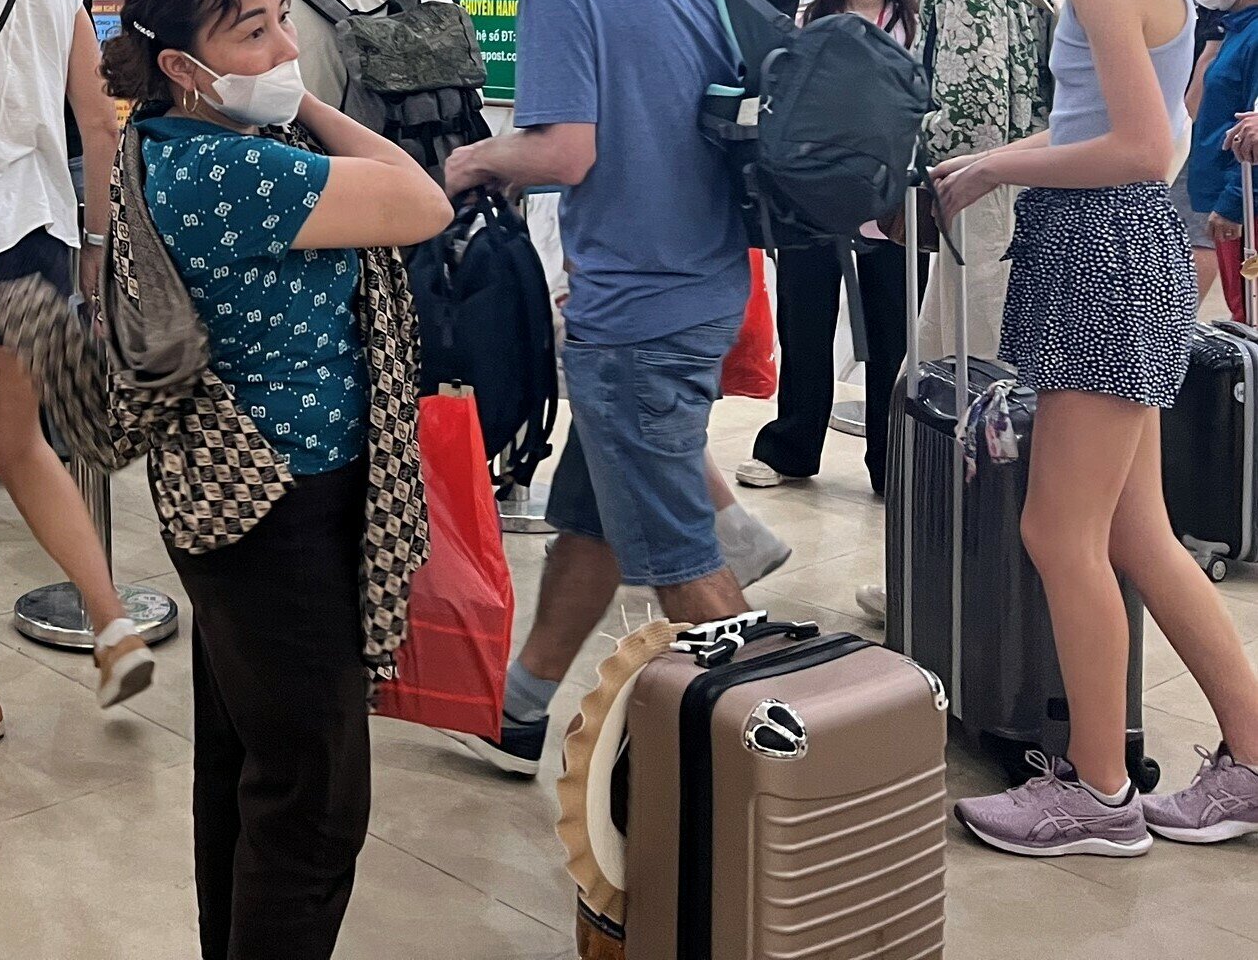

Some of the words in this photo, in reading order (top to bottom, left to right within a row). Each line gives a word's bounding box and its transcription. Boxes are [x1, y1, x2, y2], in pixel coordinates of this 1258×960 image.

[476, 29, 487, 43] hệ
[488, 28, 499, 42] số
[481, 50, 517, 63] apost.co
